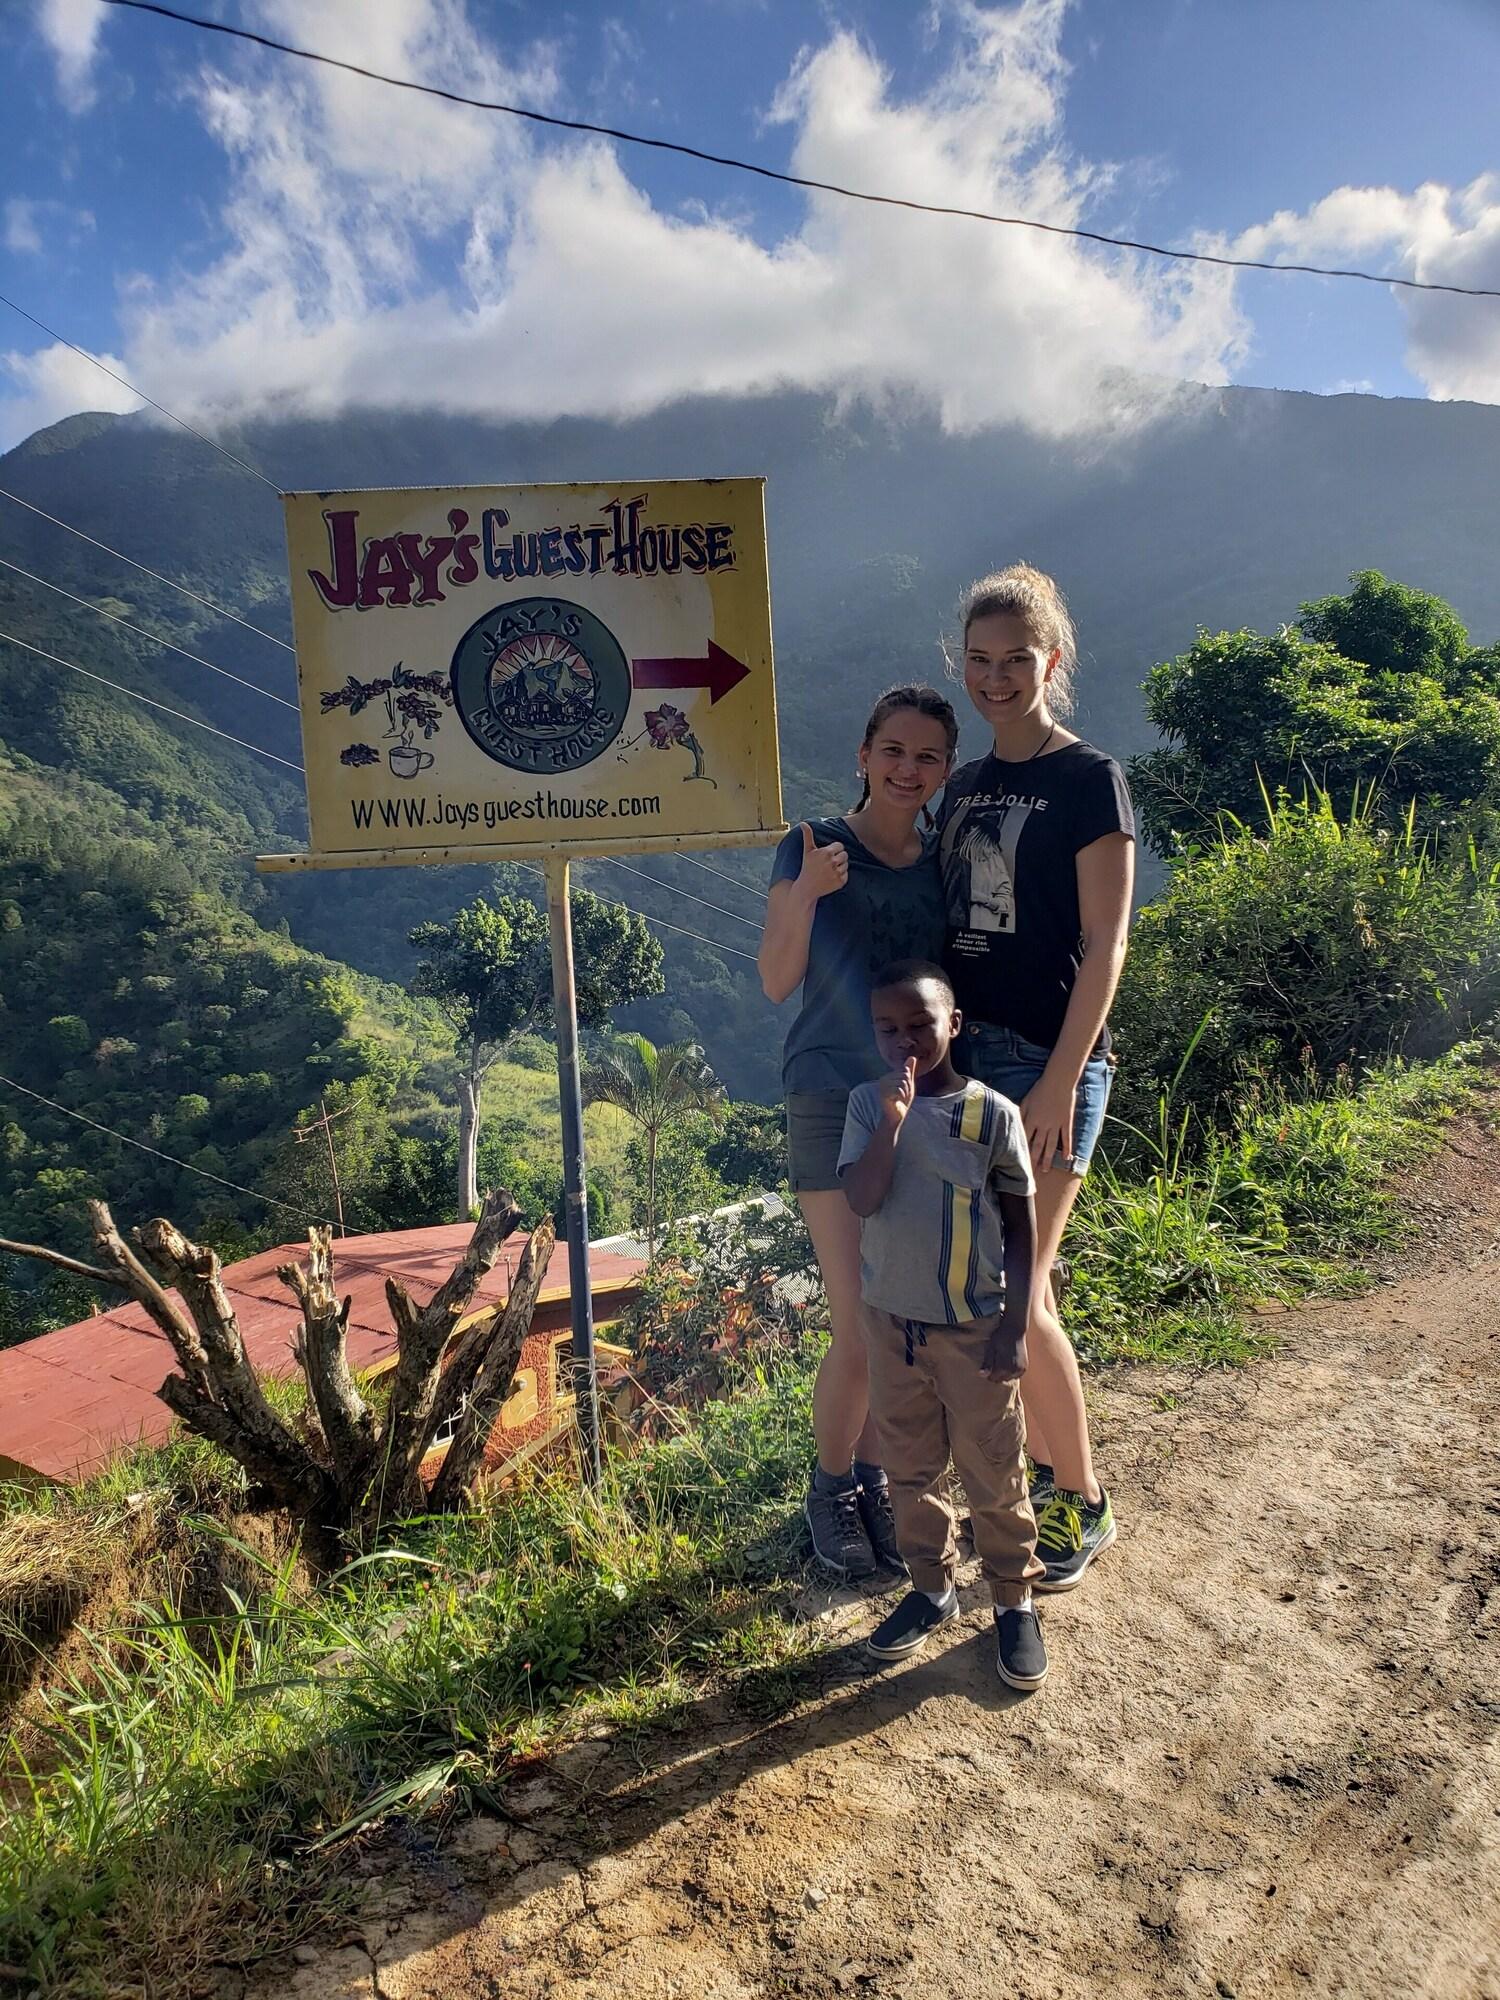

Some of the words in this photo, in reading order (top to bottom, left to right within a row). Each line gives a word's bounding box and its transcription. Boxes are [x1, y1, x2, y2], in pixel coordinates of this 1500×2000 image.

[308, 508, 481, 609] JAY'S
[481, 605, 583, 656] JAY'S
[469, 706, 543, 766] GUEST
[549, 707, 616, 768] HOUSE
[996, 794, 1049, 812] JOLIE
